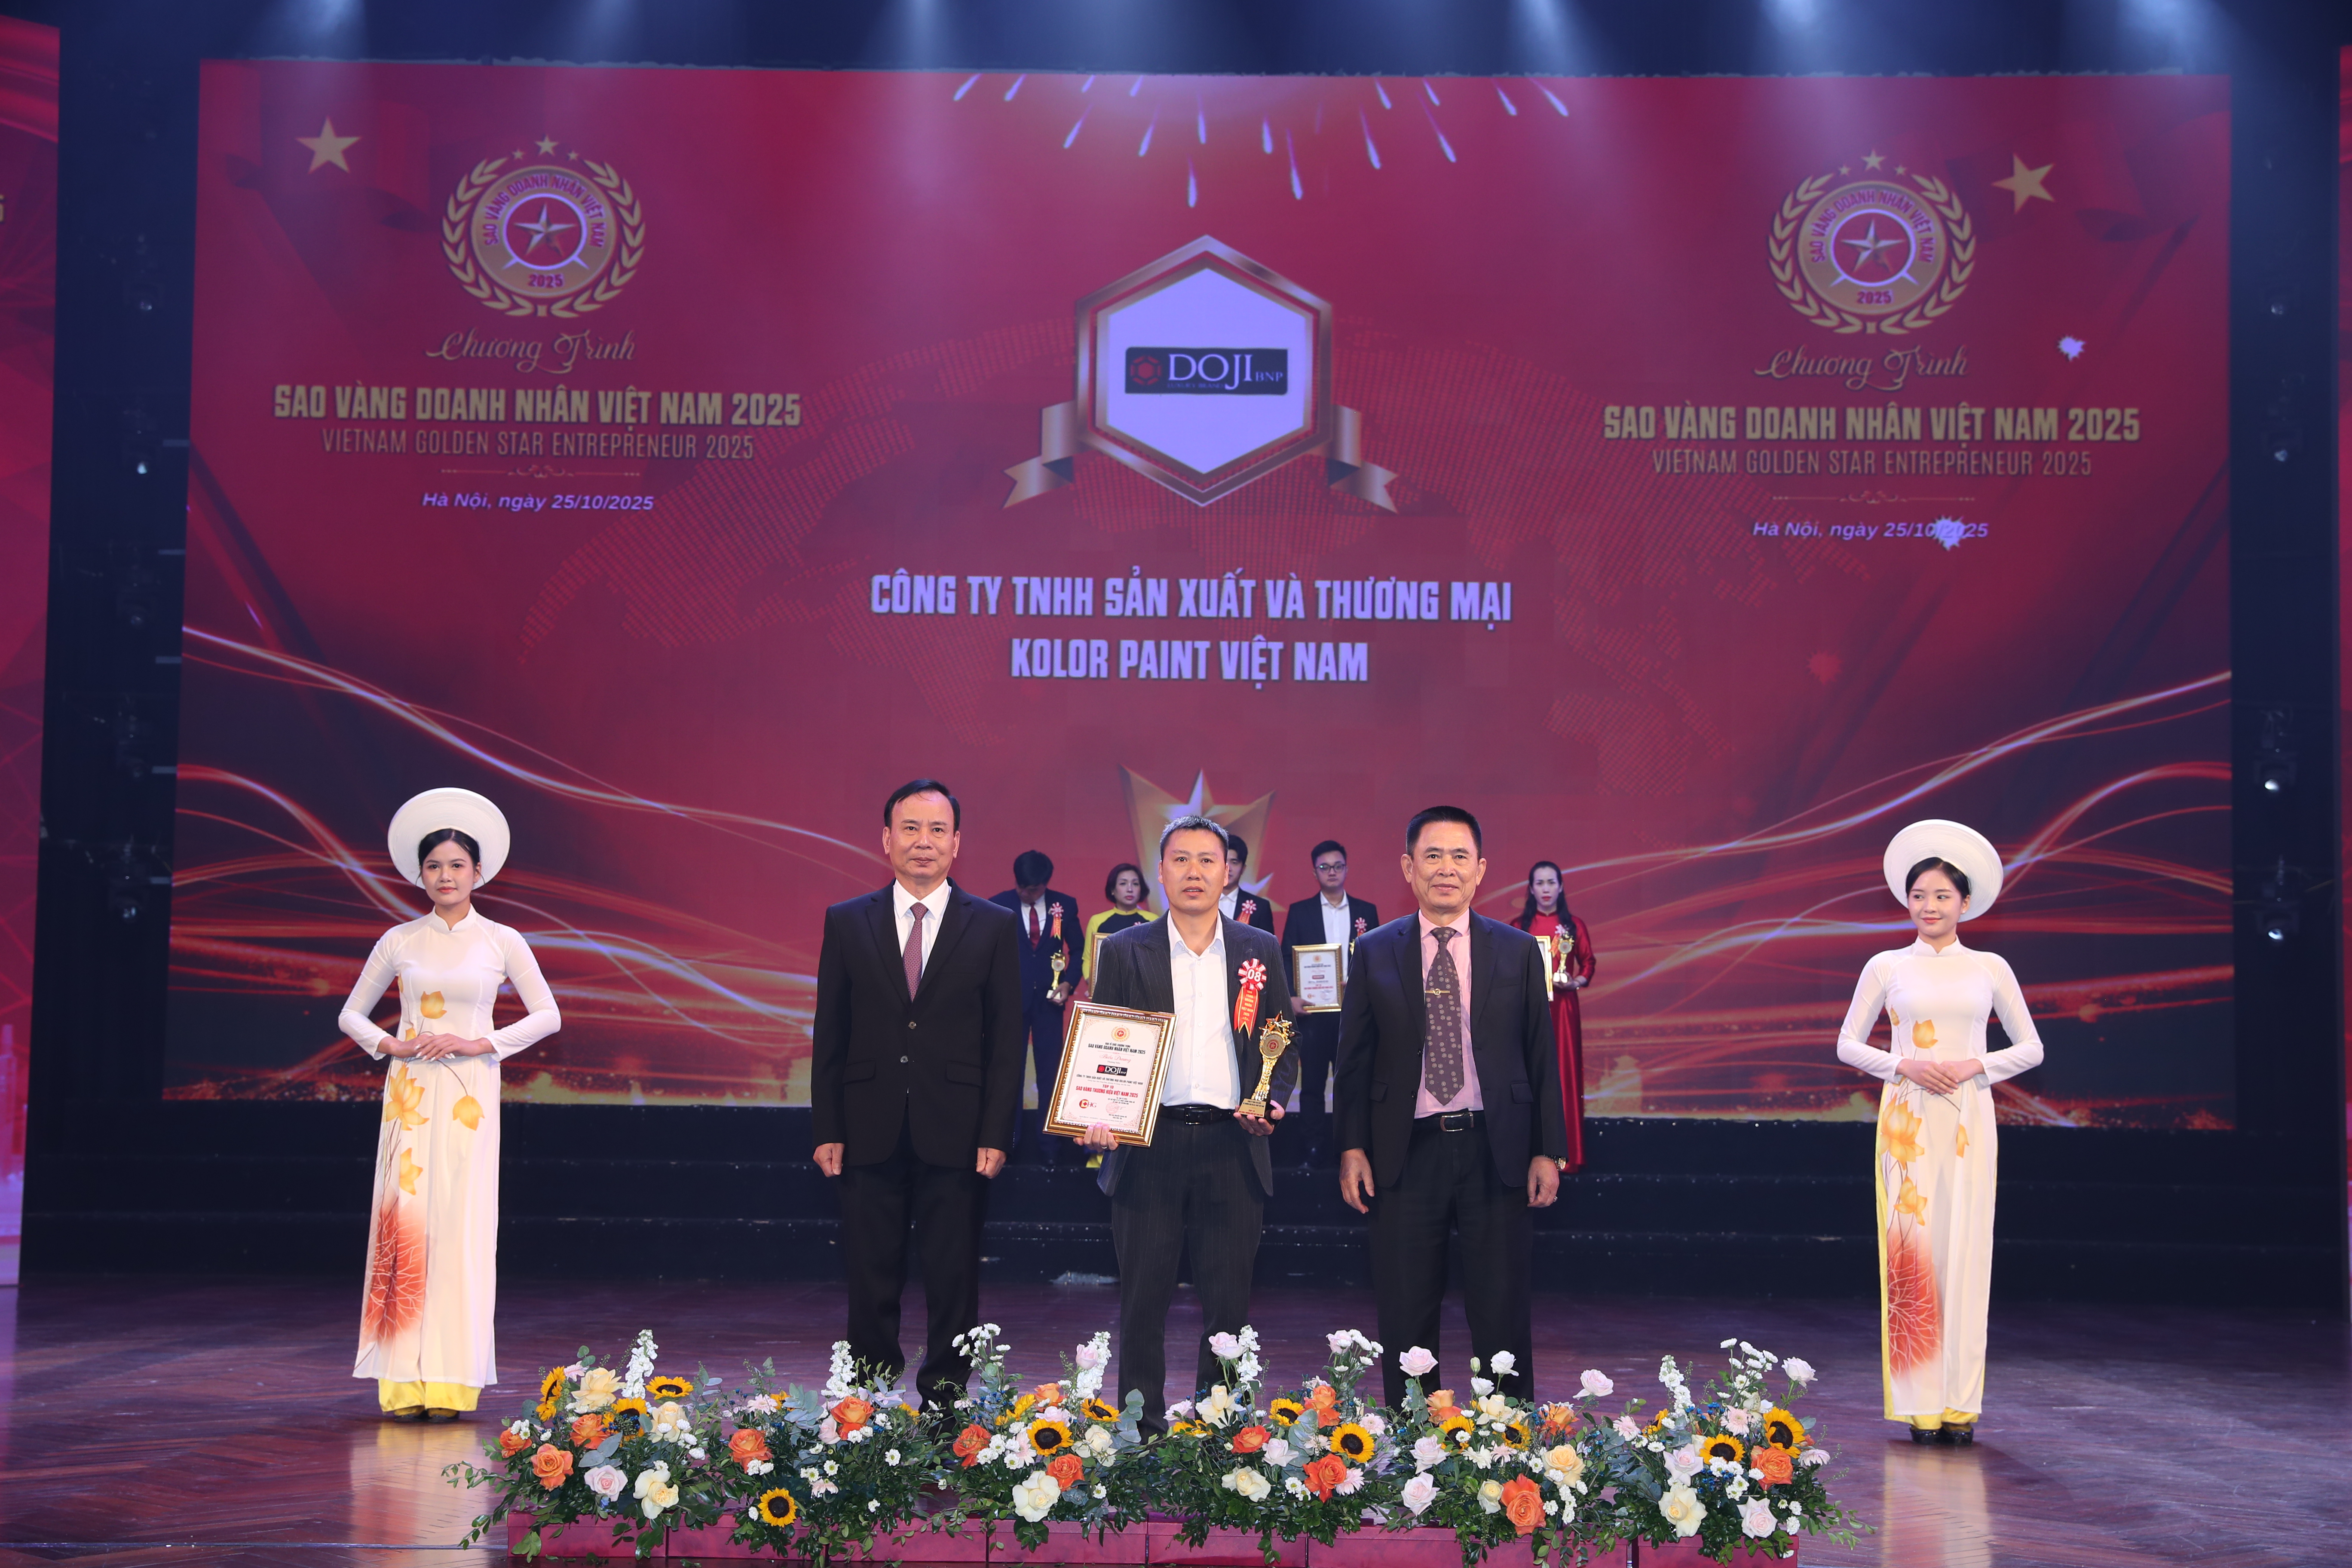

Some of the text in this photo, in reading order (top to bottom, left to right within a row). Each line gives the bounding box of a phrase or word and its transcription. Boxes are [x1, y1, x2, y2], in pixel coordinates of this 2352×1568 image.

[483, 174, 606, 248] SAO VÀNG DOANH NHÂN VIỆT NAM
[1810, 190, 1935, 263] SAO VÀNG DOANH NHÂN VIỆT NAM
[528, 273, 564, 288] 2025
[1857, 290, 1893, 304] 2025
[426, 328, 634, 374] Chương Trình
[1754, 345, 1967, 390] Chương Trình
[1169, 354, 1252, 390] DOJI
[1256, 372, 1283, 382] BNP
[275, 380, 800, 431] SAO VÀNG DOANH NHÂN VIỆT NAM 2025
[1604, 401, 2139, 448] SAO VÀNG DOANH NHÂN VIỆT NAM 2025
[323, 428, 753, 459] VIETNAM GOLDEN STAR ENTREPRENEUR 2025
[1653, 449, 2091, 475] VIETNAM GOLDEN STAR ENTREPRENEUR 2025
[422, 493, 654, 512] Hà Nội, ngày 25/10/2025
[1753, 522, 1779, 536] Hà
[1785, 521, 1822, 539] Nội,
[1829, 522, 1878, 541] ngày
[871, 566, 1511, 630] CÔNG TY TNHH SẢN XUẤT VÀ THƯƠNG MẠI
[1011, 634, 1368, 689] KOLOR PAINT VIỆT NAM
[1247, 969, 1262, 982] 08
[1105, 1066, 1122, 1075] DOJI
